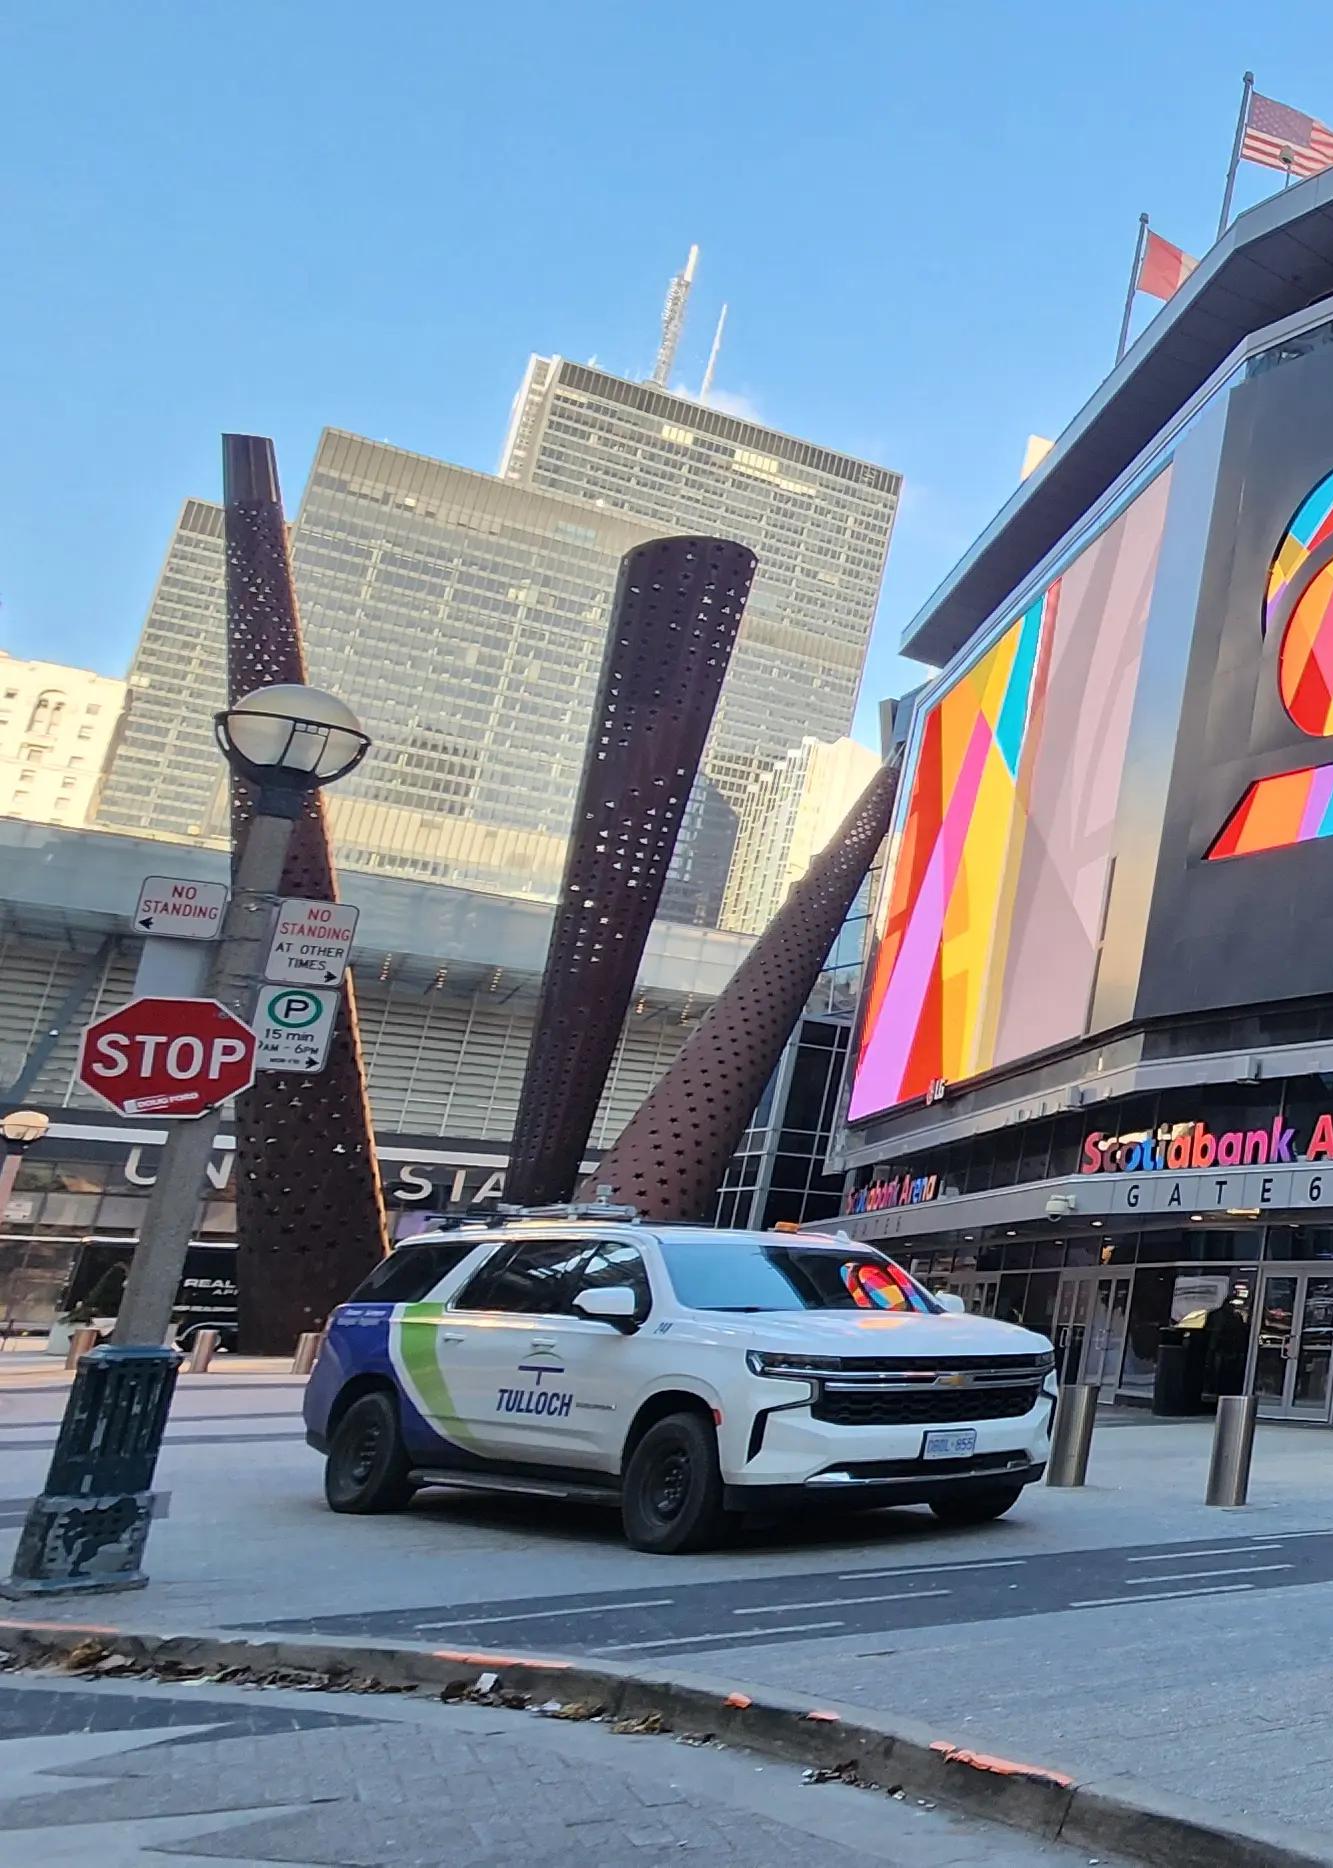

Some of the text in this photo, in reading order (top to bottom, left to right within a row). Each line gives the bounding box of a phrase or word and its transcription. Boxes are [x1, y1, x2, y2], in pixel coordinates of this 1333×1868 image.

[171, 885, 198, 900] NO
[141, 899, 219, 920] STANDING
[307, 908, 332, 923] NO
[279, 922, 351, 941] STANDING
[275, 942, 345, 958] AT OTHER
[287, 957, 327, 971] TIMES
[265, 1028, 315, 1043] 15 min
[92, 1032, 246, 1080] STOP
[294, 1044, 319, 1055] 6PM
[933, 1078, 946, 1100] LG
[1080, 1115, 1296, 1175] Scotiabank
[1126, 1176, 1322, 1208] GATE 6
[496, 1388, 574, 1418] TULLOCH
